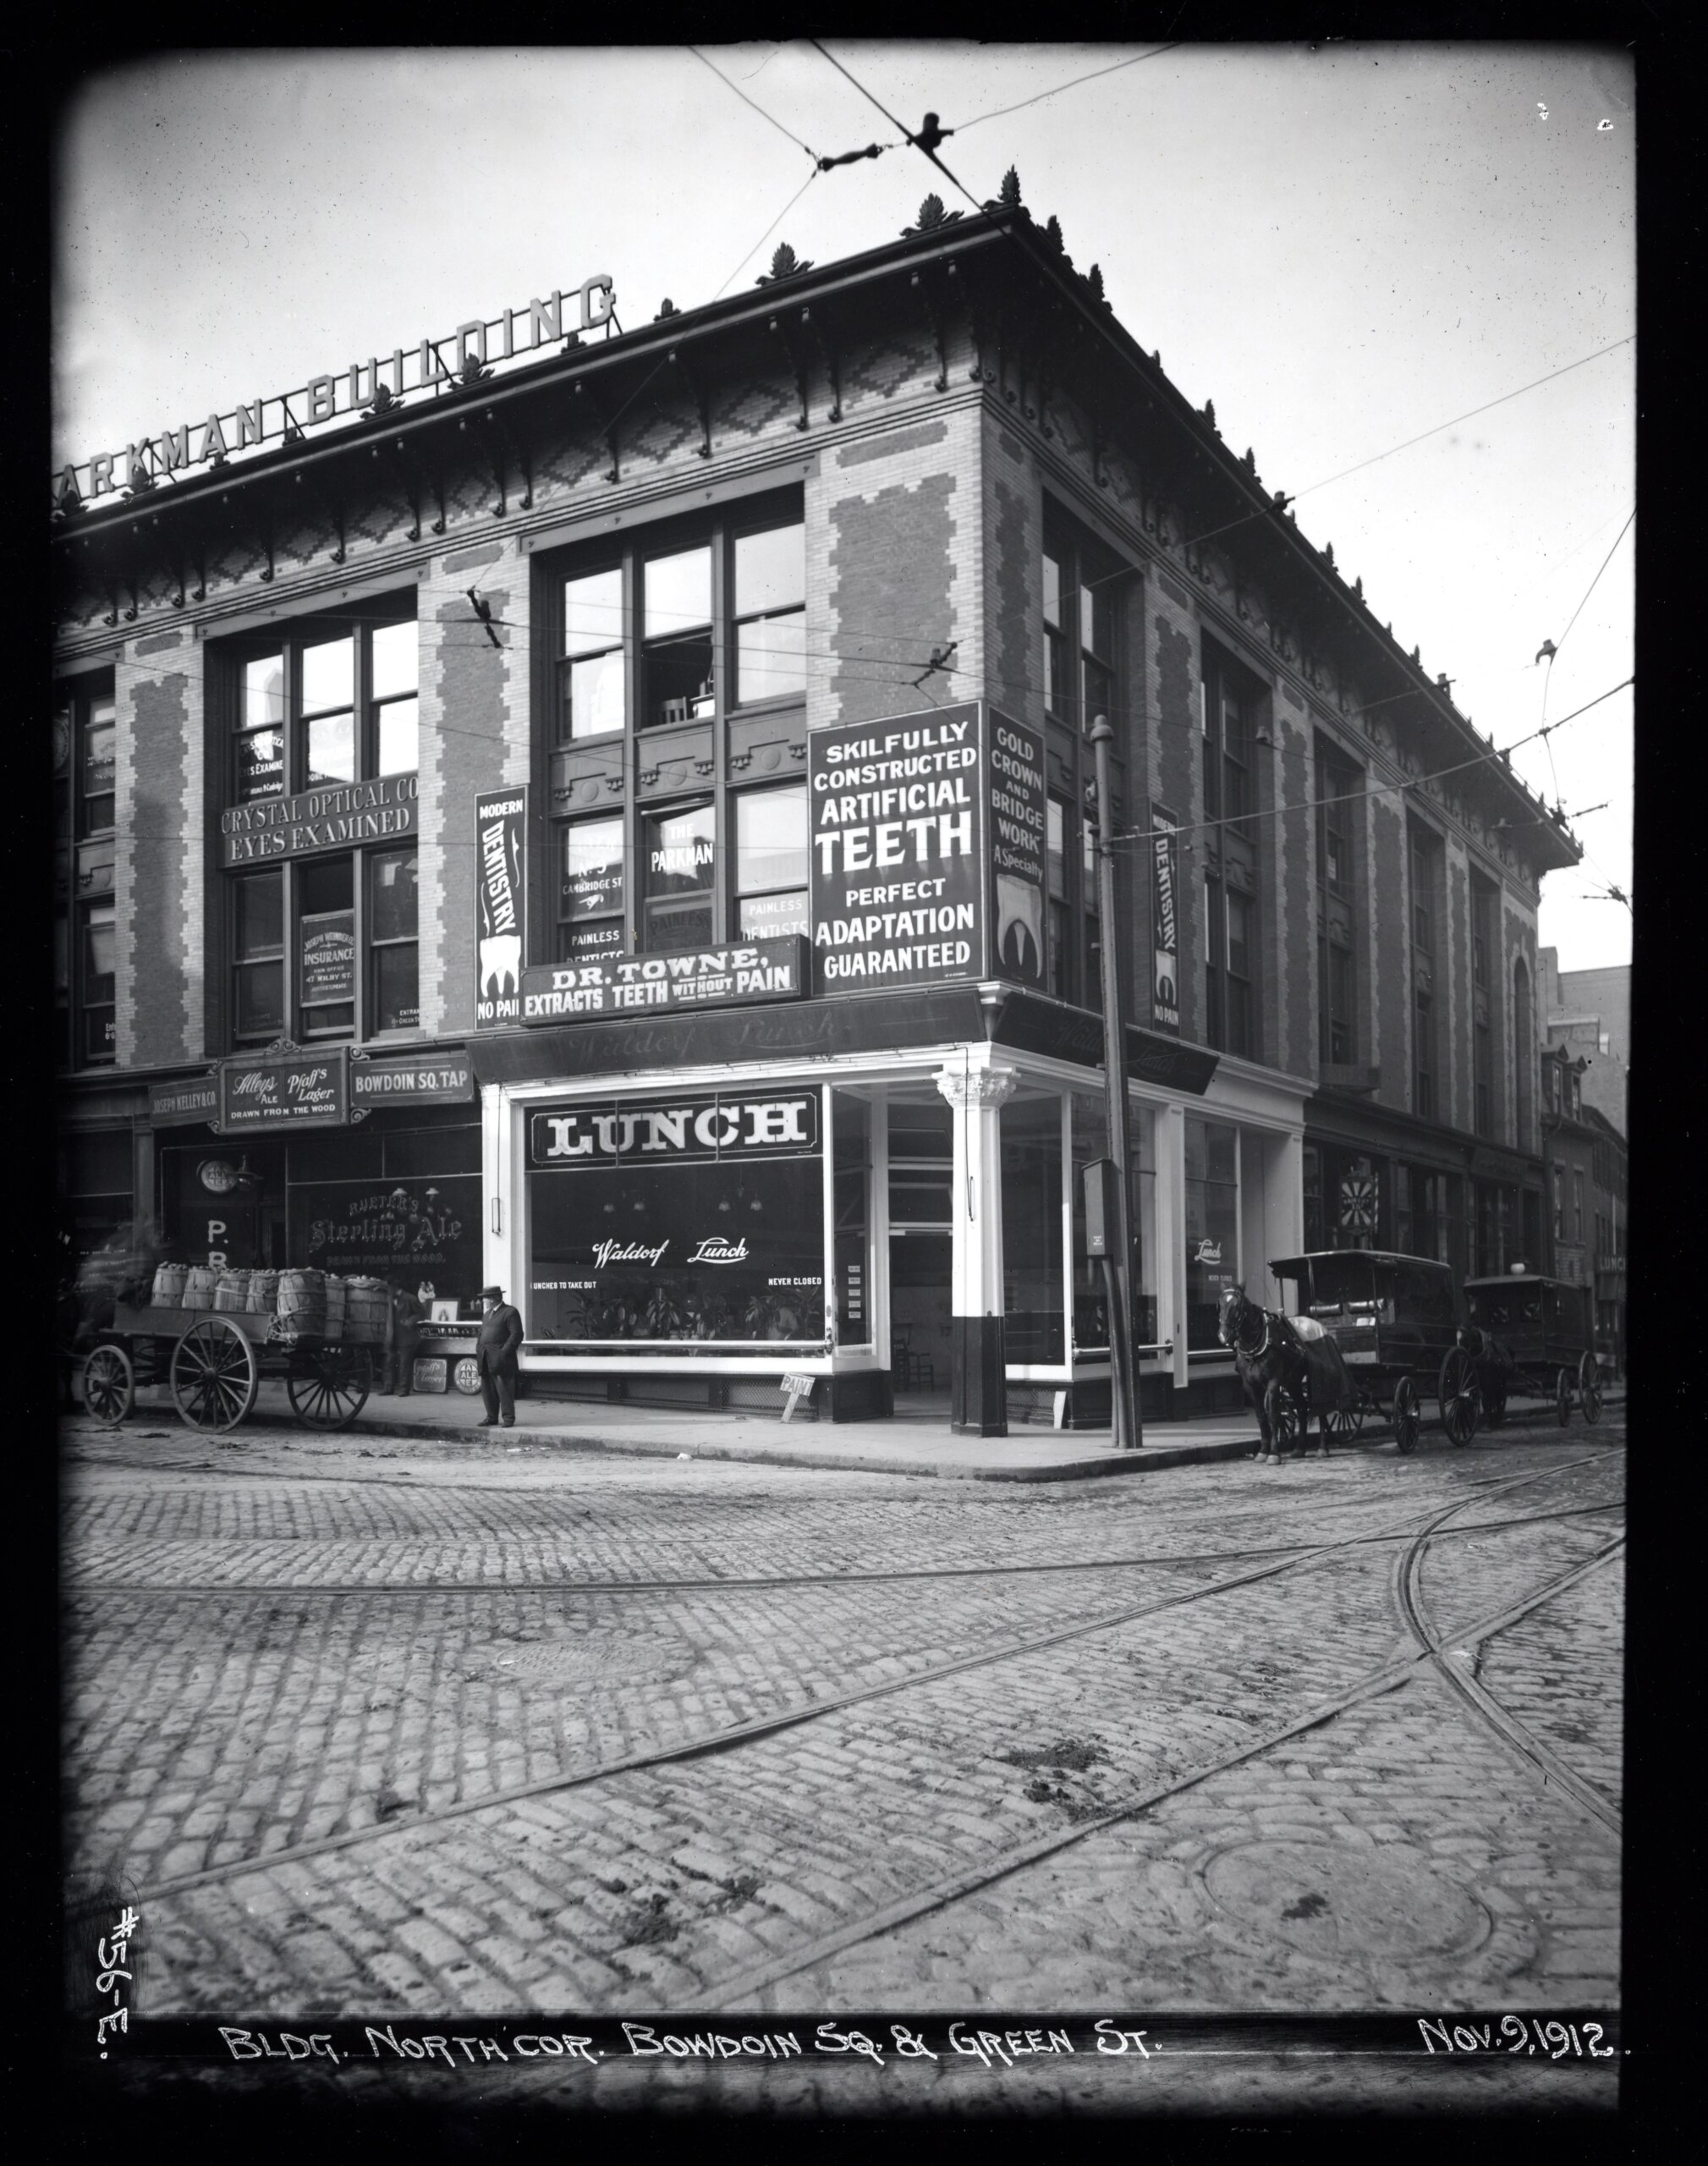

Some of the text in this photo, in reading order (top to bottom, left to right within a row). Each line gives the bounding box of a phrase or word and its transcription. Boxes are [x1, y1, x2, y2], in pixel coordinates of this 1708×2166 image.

[307, 273, 616, 426] BUILDING
[826, 721, 969, 764] SKILFULLY
[997, 727, 1034, 761] GOLD
[814, 746, 977, 792] CONSTRUCTED
[991, 750, 1042, 792] CROWN
[820, 776, 970, 825] ARTIFICIAL
[1006, 781, 1030, 800] AND
[221, 795, 302, 836] CRYSTAL
[309, 779, 390, 820] OPTICAL
[480, 799, 524, 820] MODERN
[991, 788, 1044, 831] BRIDGE
[230, 807, 410, 862] EYES EXAMINED
[669, 823, 695, 840] THE
[814, 811, 972, 875] TEETH
[997, 817, 1041, 855] WORK
[651, 842, 714, 873] PARKMAN
[994, 844, 1043, 883] A Specialty
[481, 819, 517, 934] DENTISTRY
[563, 878, 611, 895] CAMBRIDGE
[750, 899, 803, 915] PAINLESS
[846, 877, 946, 908] PERFECT
[1155, 838, 1176, 950] DENTISTRY
[572, 930, 620, 946] PAINLESS
[815, 903, 974, 946] ADAPTATION
[304, 948, 354, 965] INSURANCE
[552, 947, 769, 990] DR. TOWNE,
[823, 940, 971, 980] GUARANTEED
[524, 965, 791, 1016] EXTRACTS TEETH WITHOUT PAIN
[477, 1002, 495, 1020] NO
[1155, 1003, 1179, 1026] NO PAIN
[288, 1068, 328, 1095] Pfaff's
[298, 1087, 335, 1103] Lager
[355, 1069, 468, 1092] BOWDOIN SQ. TAP
[152, 1097, 176, 1115] JOSEPH
[230, 1103, 336, 1120] DRAWN FROM THE WOOD
[260, 1093, 278, 1105] ALE
[546, 1100, 808, 1157] LUNCH
[347, 1195, 420, 1219] RUETER'S
[307, 1216, 464, 1253] Sterling Ale
[591, 1236, 750, 1269] Waldorf Lunch
[1194, 1238, 1222, 1265] Lunch
[558, 1281, 568, 1289] TO
[568, 1281, 583, 1289] TAKE
[768, 1277, 822, 1286] NEVER CLOSED
[782, 1375, 813, 1396] PAINT
